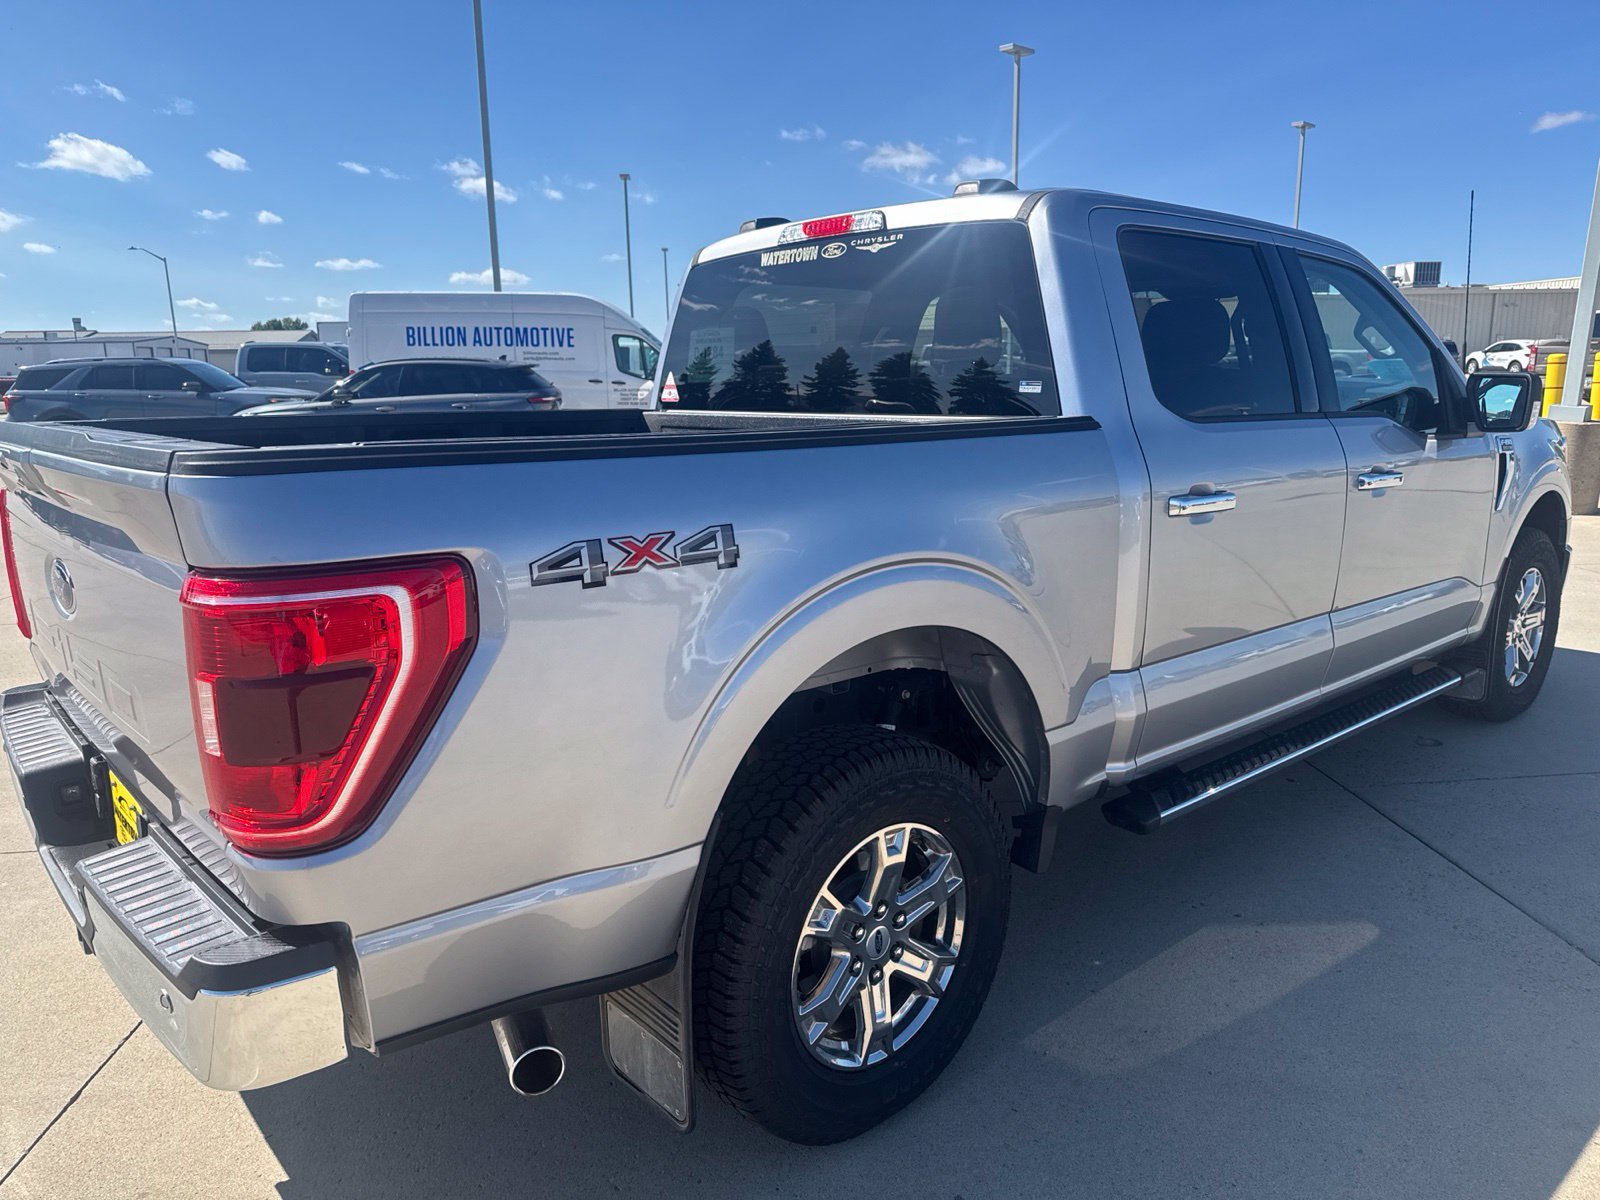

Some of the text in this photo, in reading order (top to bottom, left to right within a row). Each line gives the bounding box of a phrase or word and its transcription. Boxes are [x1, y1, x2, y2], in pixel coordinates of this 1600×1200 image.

[760, 233, 904, 267] WATERTOWN Ford CHRYSLER
[405, 326, 575, 348] BILLION AUTOMOTIVE
